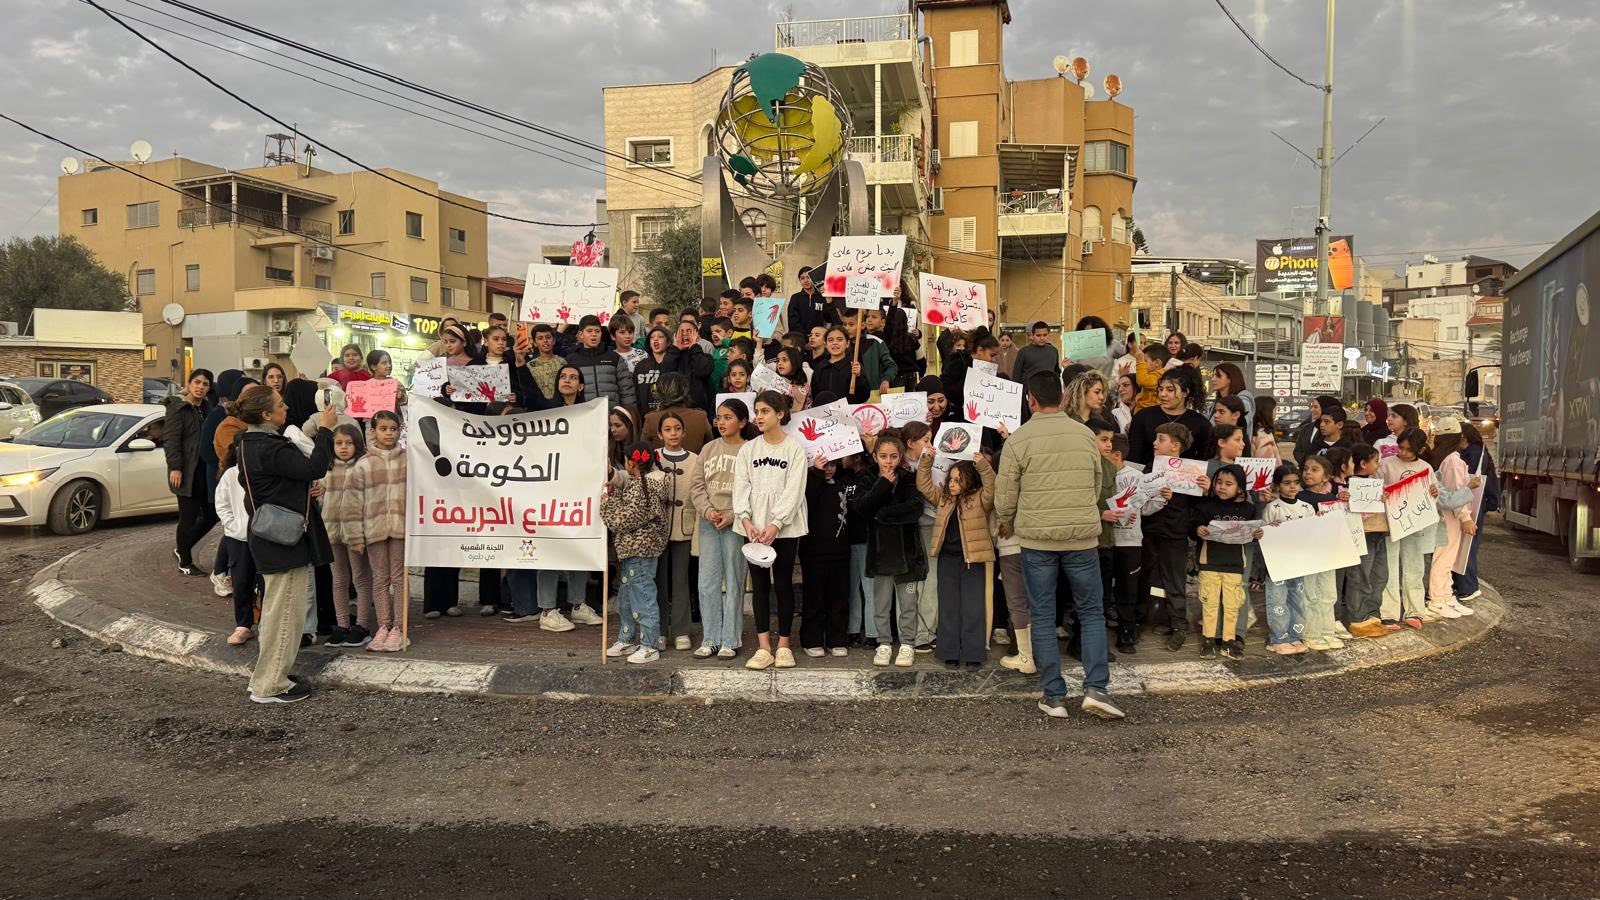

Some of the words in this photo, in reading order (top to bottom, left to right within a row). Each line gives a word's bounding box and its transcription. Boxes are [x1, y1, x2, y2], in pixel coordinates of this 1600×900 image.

[413, 317, 438, 334] TOP
[461, 416, 570, 447] مسؤولية
[456, 452, 561, 488] الحكومة
[432, 497, 515, 533] الجريمة
[522, 497, 592, 534] اقتلاع
